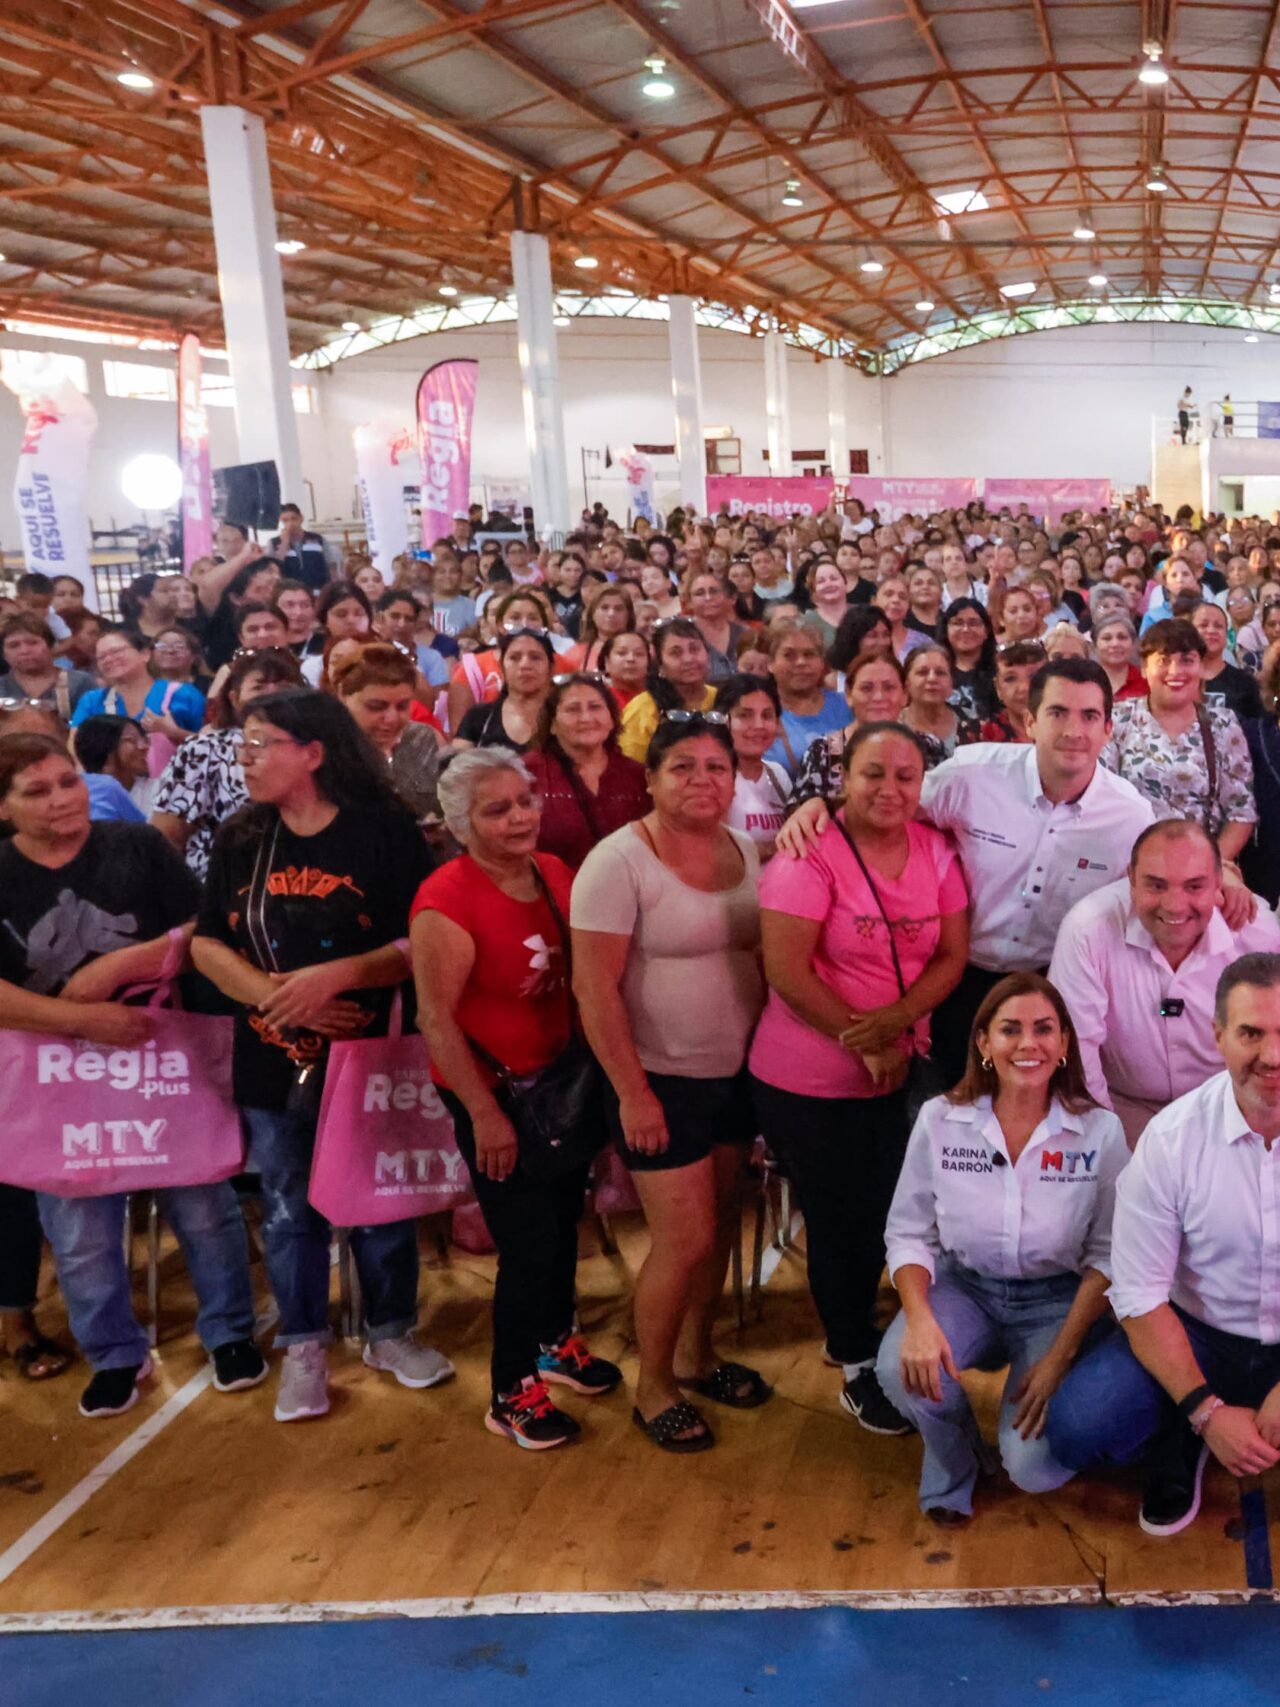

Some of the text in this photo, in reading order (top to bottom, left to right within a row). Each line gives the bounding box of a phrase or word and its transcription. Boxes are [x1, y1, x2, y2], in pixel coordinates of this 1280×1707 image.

[18, 487, 34, 508] SE
[32, 472, 65, 561] RESUELVE
[746, 813, 784, 831] PUM
[62, 1118, 167, 1156] MTY
[942, 1146, 988, 1160] KARINA
[1041, 1150, 1097, 1174] MTY
[375, 1150, 463, 1183] MTY
[941, 1159, 993, 1173] BARRÓN
